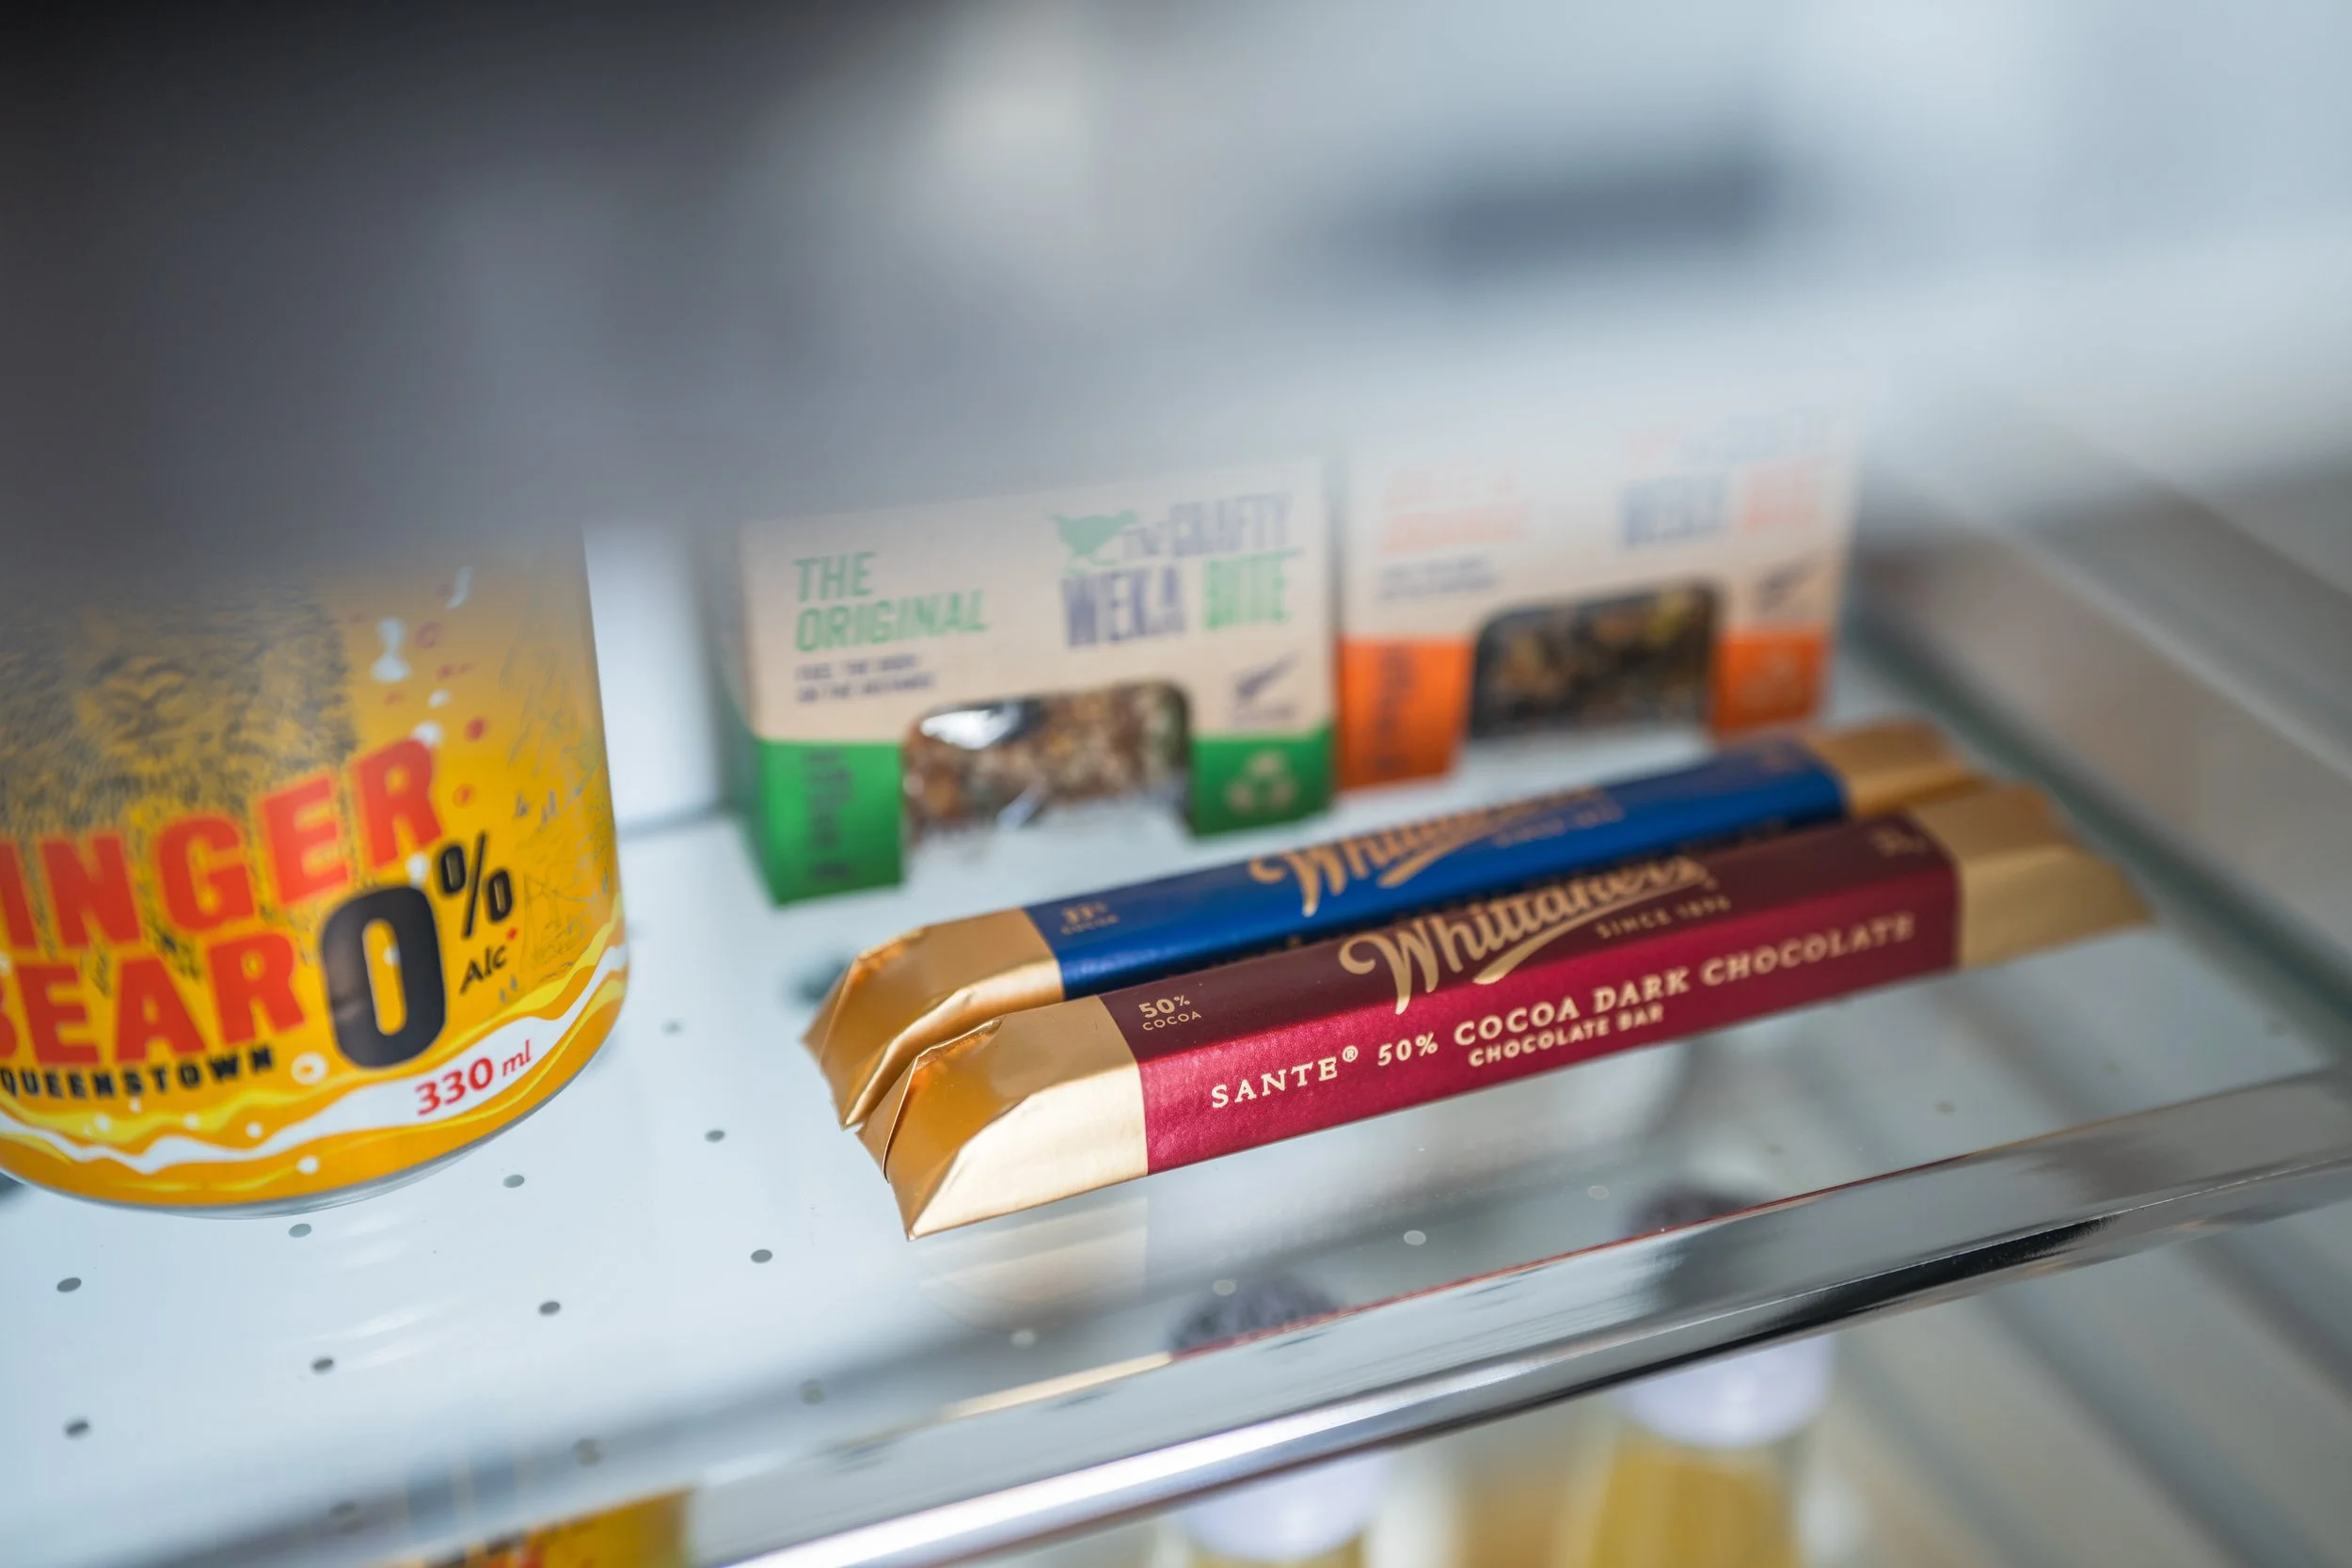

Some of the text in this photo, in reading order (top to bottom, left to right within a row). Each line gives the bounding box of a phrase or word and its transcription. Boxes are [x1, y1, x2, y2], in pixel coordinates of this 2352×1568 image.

[792, 551, 876, 602] THE
[795, 589, 991, 651] ORIGINAL
[1596, 908, 1672, 939] SINCE
[0, 932, 306, 1066] EAR
[1138, 995, 1191, 1019] 50%
[1377, 1032, 1438, 1067] 50%
[1453, 995, 1580, 1047] COCOA
[1593, 967, 1691, 1014] DARK
[1700, 912, 1916, 988] CHOCOLATE
[1142, 1011, 1202, 1031] COCOA
[1468, 1004, 1665, 1069] CHOCOLATE BAR
[414, 1038, 532, 1117] 330 ml
